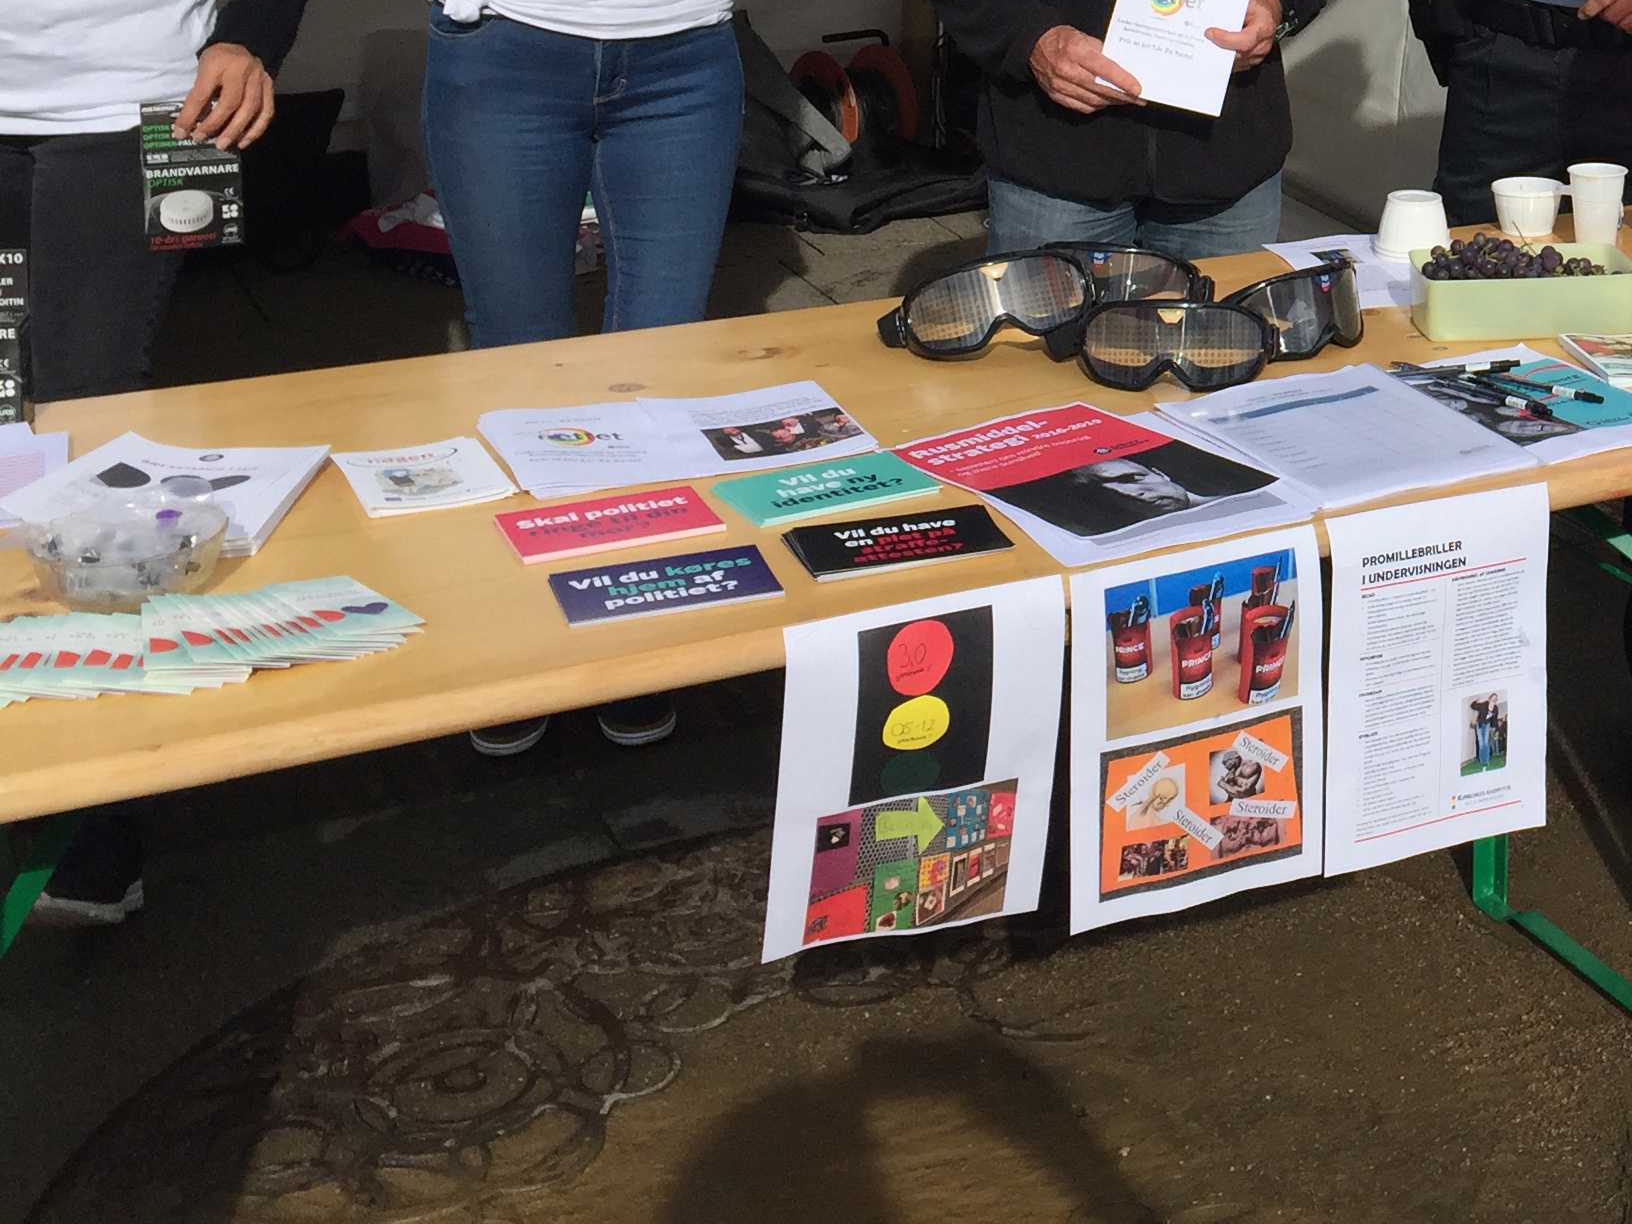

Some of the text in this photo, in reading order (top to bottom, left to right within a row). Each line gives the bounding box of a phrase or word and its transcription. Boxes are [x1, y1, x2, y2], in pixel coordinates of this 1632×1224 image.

[145, 163, 240, 180] BRANDVARNARE
[908, 419, 1048, 459] Rusmiddel-
[927, 433, 1030, 466] strategi
[776, 473, 878, 499] have ny
[778, 465, 857, 488] Vil du
[771, 477, 904, 509] identitet?
[515, 495, 689, 531] Skal politiet
[833, 518, 957, 540] Vil du have
[844, 537, 874, 548] en
[877, 531, 923, 546] plet
[1362, 540, 1463, 569] PROMILLEBRILLER
[568, 576, 612, 591] Vil
[619, 569, 659, 584] du
[608, 569, 726, 597] hjem af
[1361, 556, 1467, 586] I UNDERVISNINGEN
[603, 579, 740, 611] politiet?
[1239, 735, 1281, 767] Steroider
[1115, 760, 1163, 804] Steroider
[1236, 800, 1288, 816] Steroider
[1175, 808, 1214, 844] Steroider
